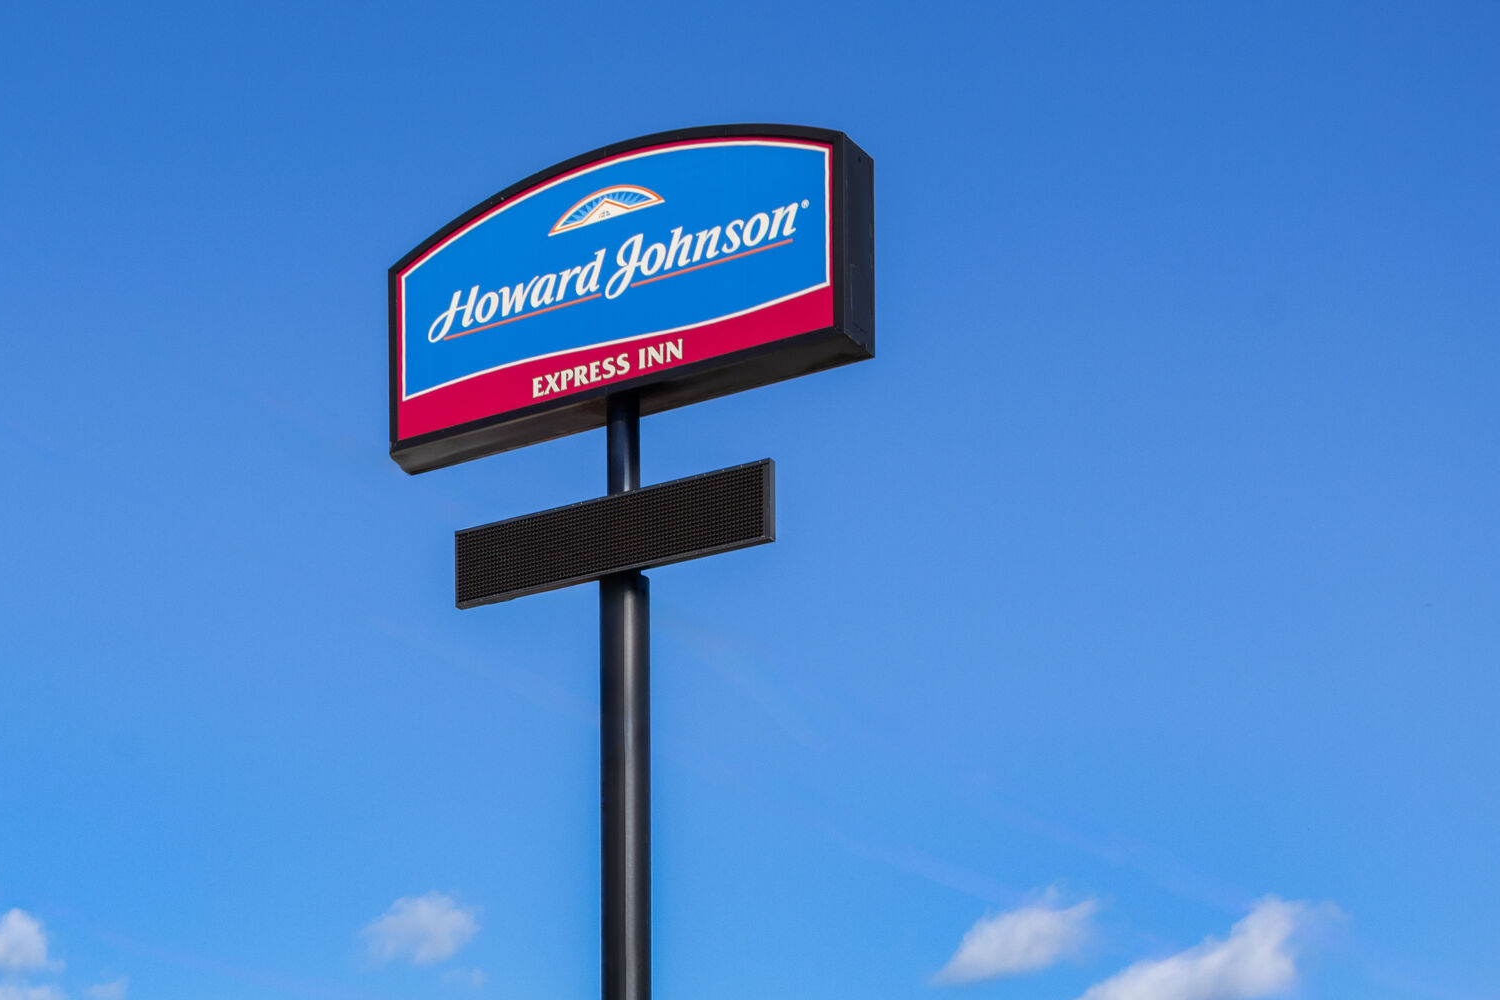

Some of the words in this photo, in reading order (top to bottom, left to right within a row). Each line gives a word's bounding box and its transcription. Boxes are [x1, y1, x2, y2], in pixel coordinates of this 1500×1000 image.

[428, 247, 606, 343] Howard
[532, 353, 630, 399] EXPRESS
[638, 338, 683, 370] INN
